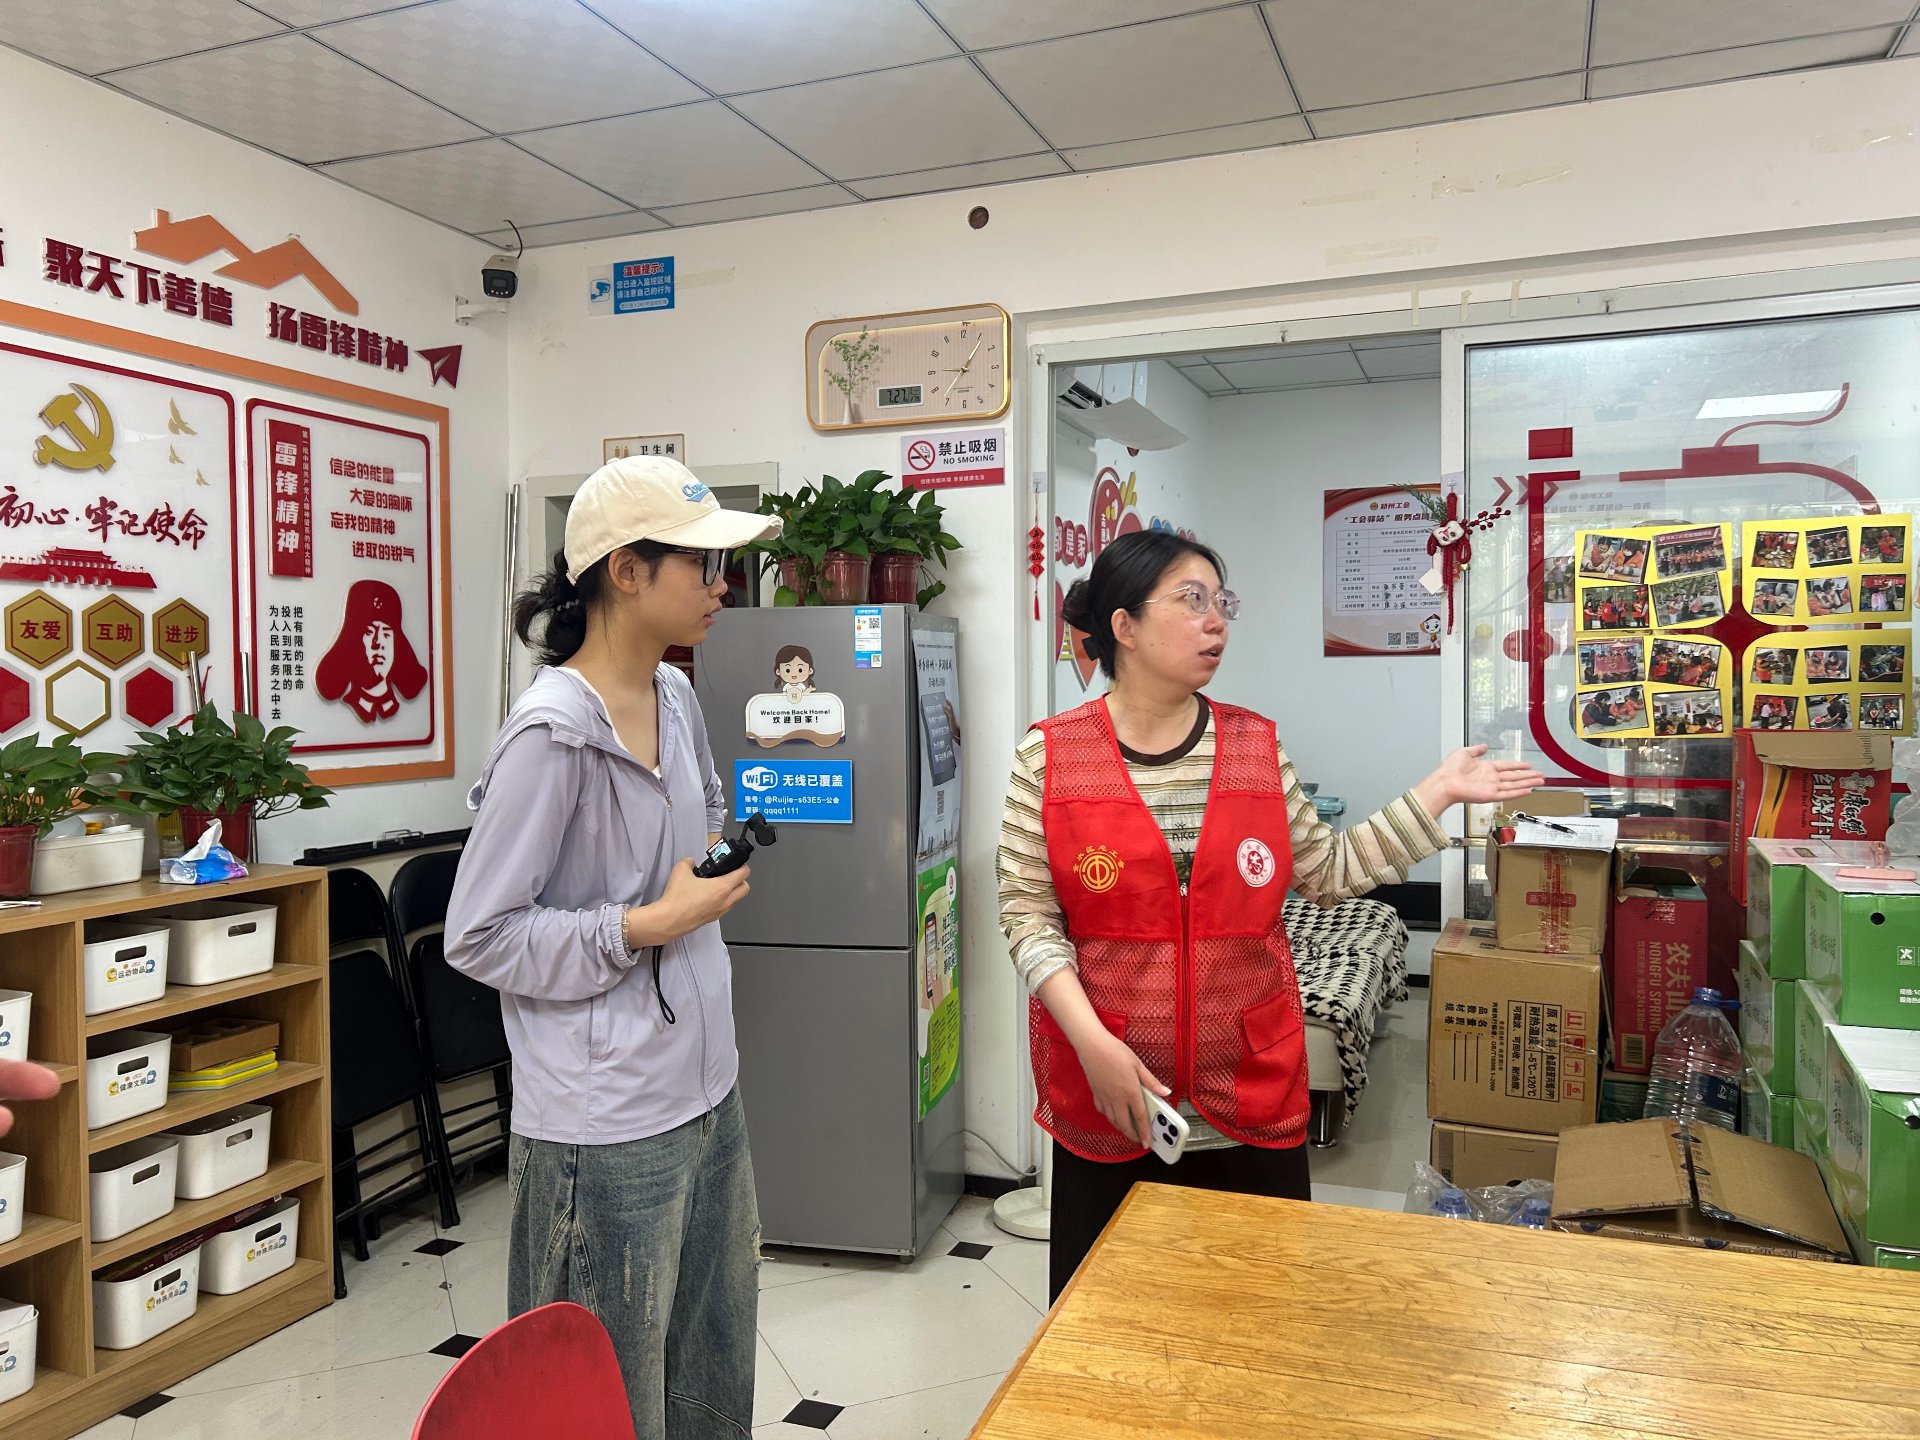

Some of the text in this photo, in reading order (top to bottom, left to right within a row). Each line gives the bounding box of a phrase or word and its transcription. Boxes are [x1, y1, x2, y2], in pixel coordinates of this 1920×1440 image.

[43, 238, 233, 327] 聚天下善德
[267, 302, 409, 372] 扬雷锋精神
[640, 444, 674, 455] 卫生间
[938, 438, 997, 456] 禁止吸烟
[330, 457, 394, 484] 信念的能量
[943, 454, 995, 465] NO SMOKING
[275, 441, 300, 553] 雷锋精神
[350, 488, 413, 513] 大爱的胸怀
[330, 512, 396, 535] 忘我的精神
[352, 540, 415, 563] 进取的锐气
[19, 619, 62, 641] 友爱
[96, 623, 133, 642] 互助
[165, 625, 200, 644] 进步
[282, 605, 293, 690] 投入到无限的
[293, 606, 304, 690] 把有限的生命
[269, 605, 281, 720] 为人民服务之中去
[773, 716, 818, 724] 欢迎回家！
[782, 774, 843, 787] 无线已覆盖
[764, 807, 799, 815] qqqq1111
[1172, 832, 1196, 841] nice
[118, 966, 146, 979] 运动物品
[1649, 941, 1661, 1032] NONGFU SPRING
